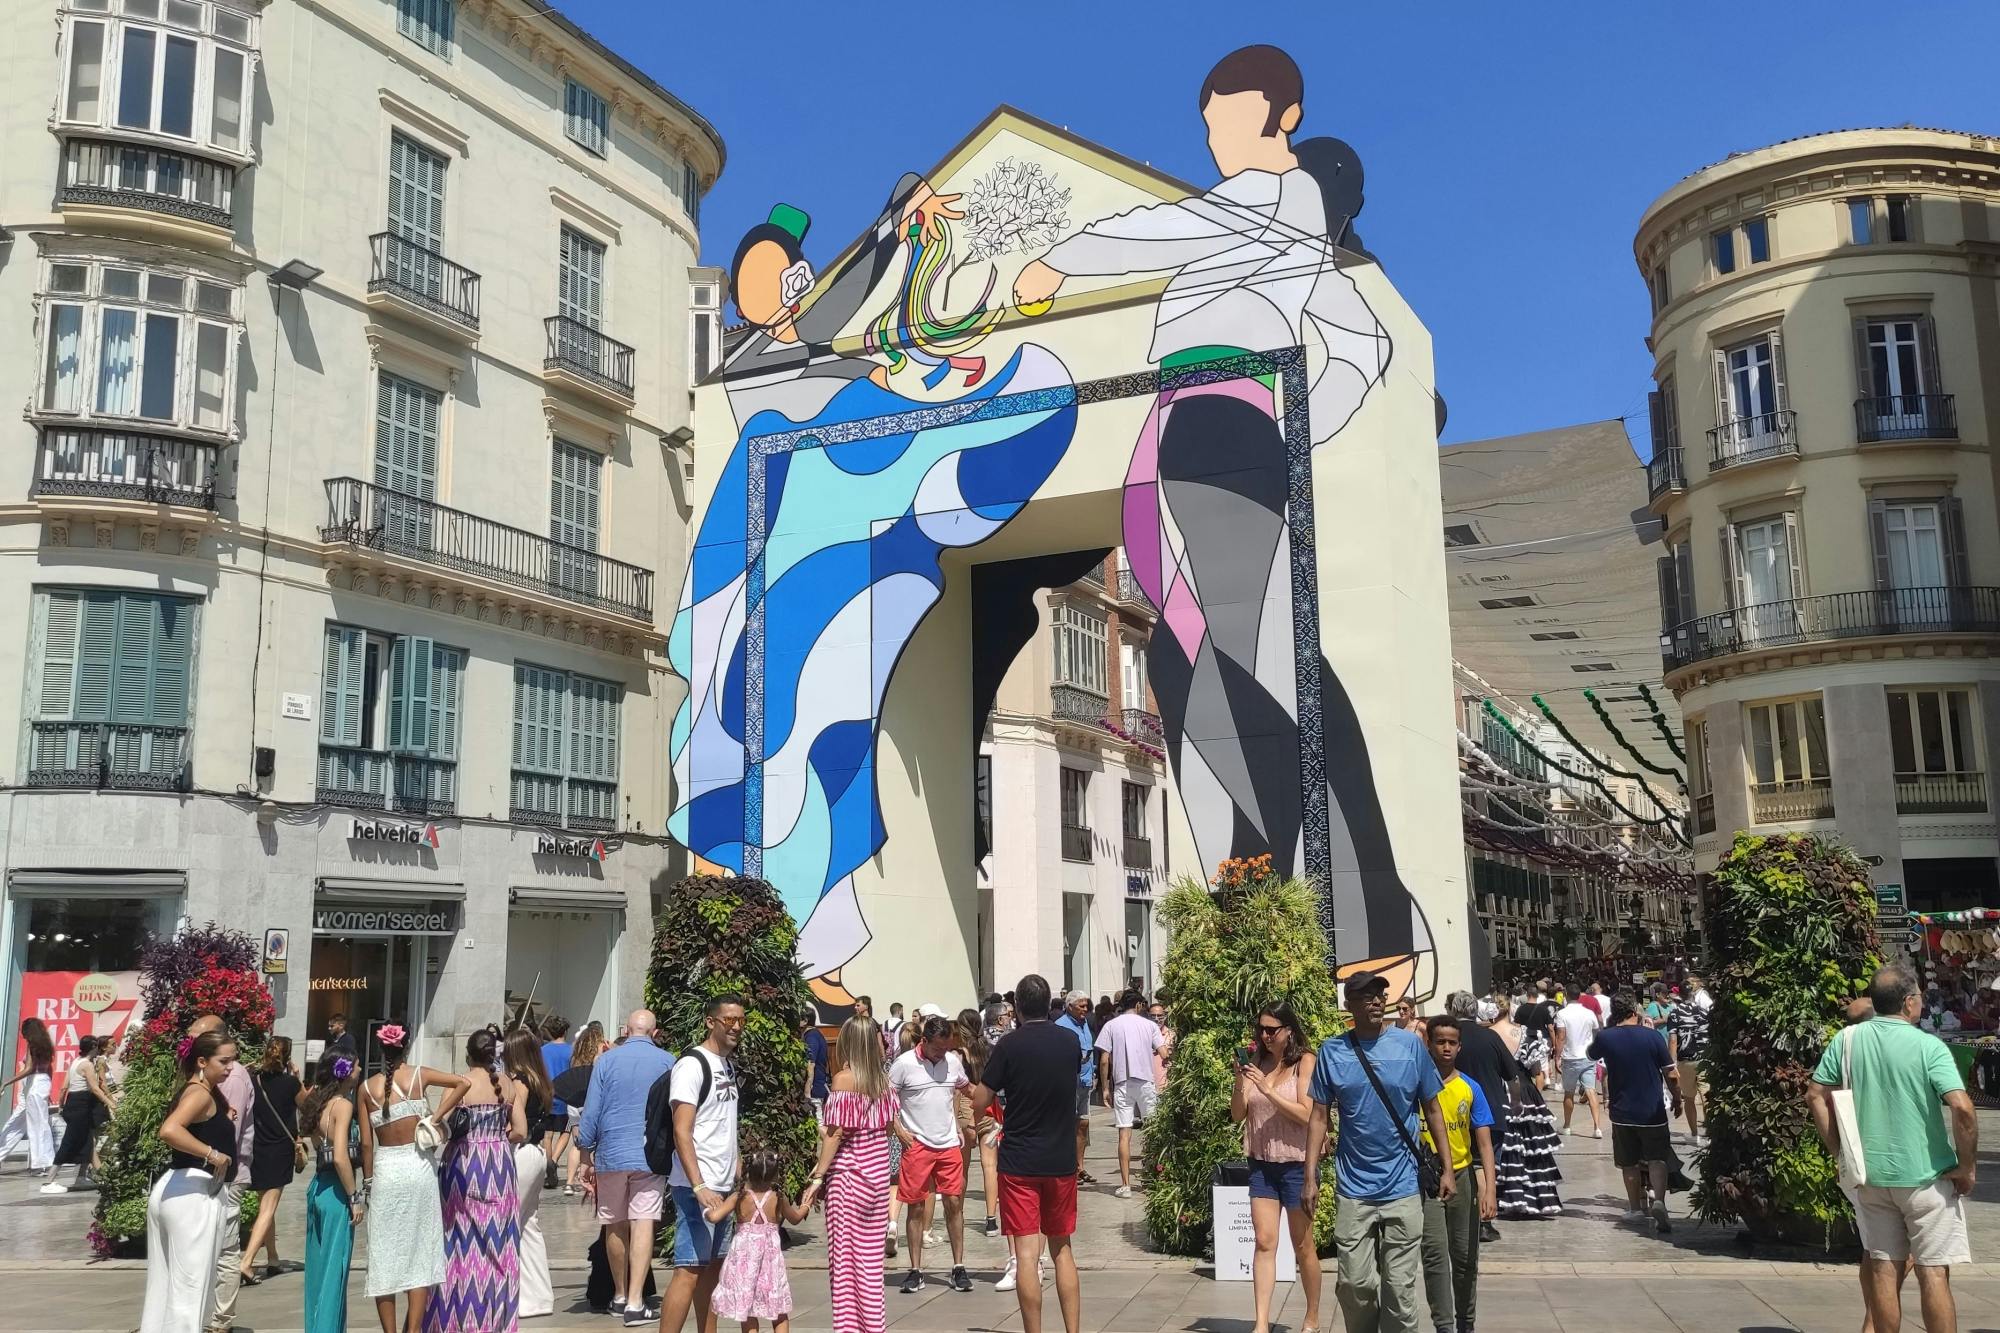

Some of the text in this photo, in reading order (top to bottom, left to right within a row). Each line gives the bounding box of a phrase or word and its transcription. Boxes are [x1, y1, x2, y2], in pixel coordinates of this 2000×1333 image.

[353, 819, 420, 843] helvetia
[538, 836, 590, 857] helvetia
[1127, 875, 1151, 893] BBVA
[316, 910, 447, 930] women'secret
